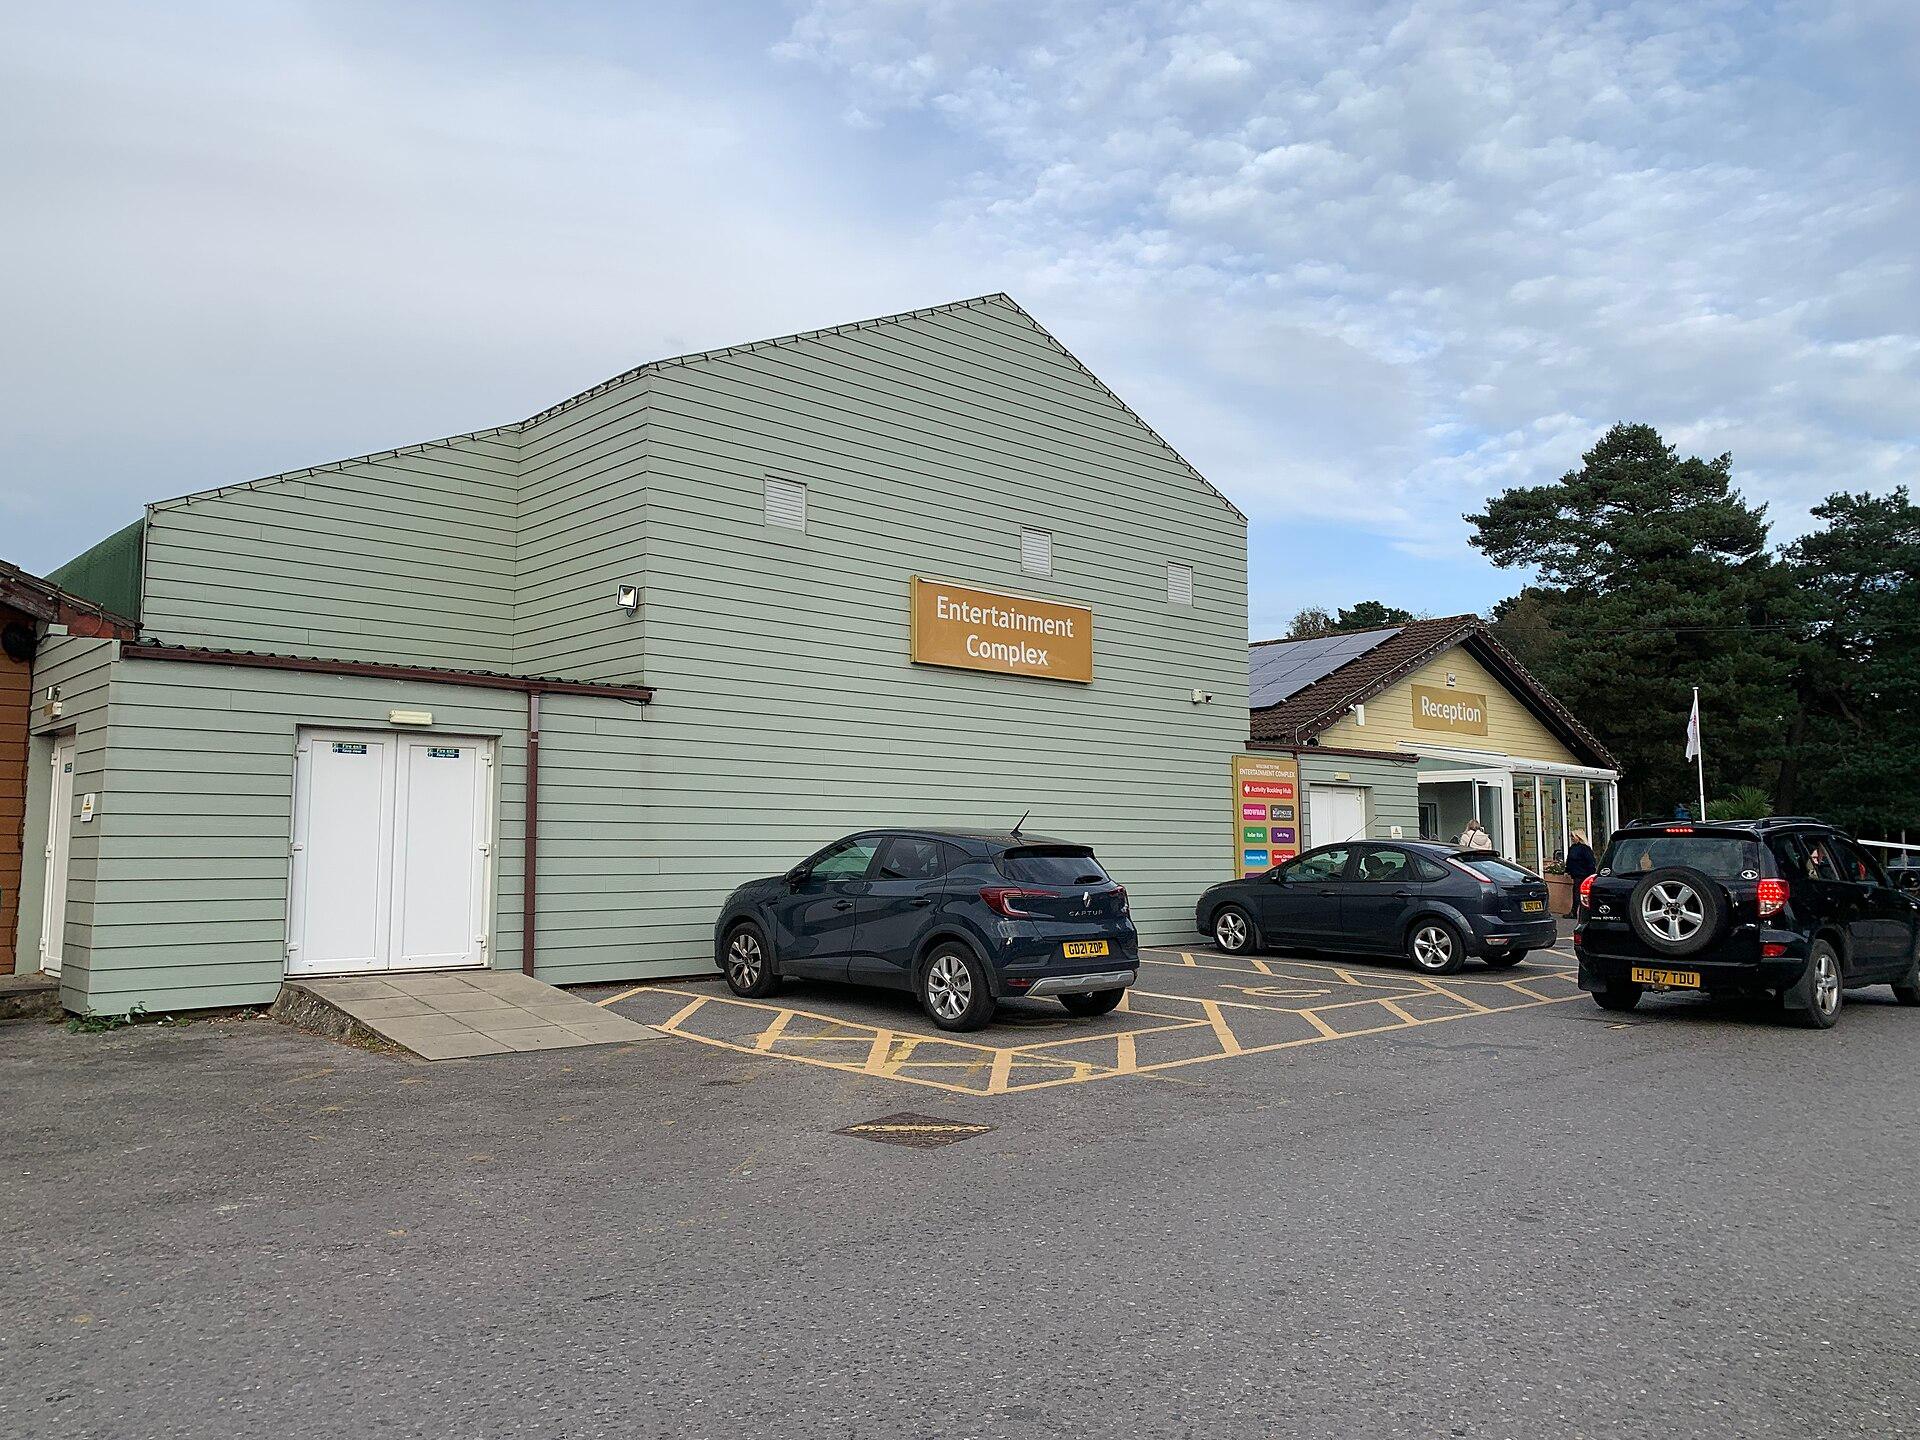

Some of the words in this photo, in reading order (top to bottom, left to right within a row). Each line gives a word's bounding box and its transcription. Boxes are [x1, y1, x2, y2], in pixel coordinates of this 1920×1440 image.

[937, 595, 1074, 638] Entertainment
[966, 634, 1049, 667] Complex
[1421, 695, 1481, 725] Reception
[1239, 768, 1275, 777] ENTERTAINMENT
[1275, 770, 1296, 778] COMPLEX
[1250, 786, 1266, 794] Activity
[1266, 787, 1283, 795] Booking
[1068, 909, 1103, 917] CAPTUR
[1068, 943, 1088, 955] GD21
[1088, 942, 1103, 954] ZDP
[1670, 972, 1695, 985] TDU
